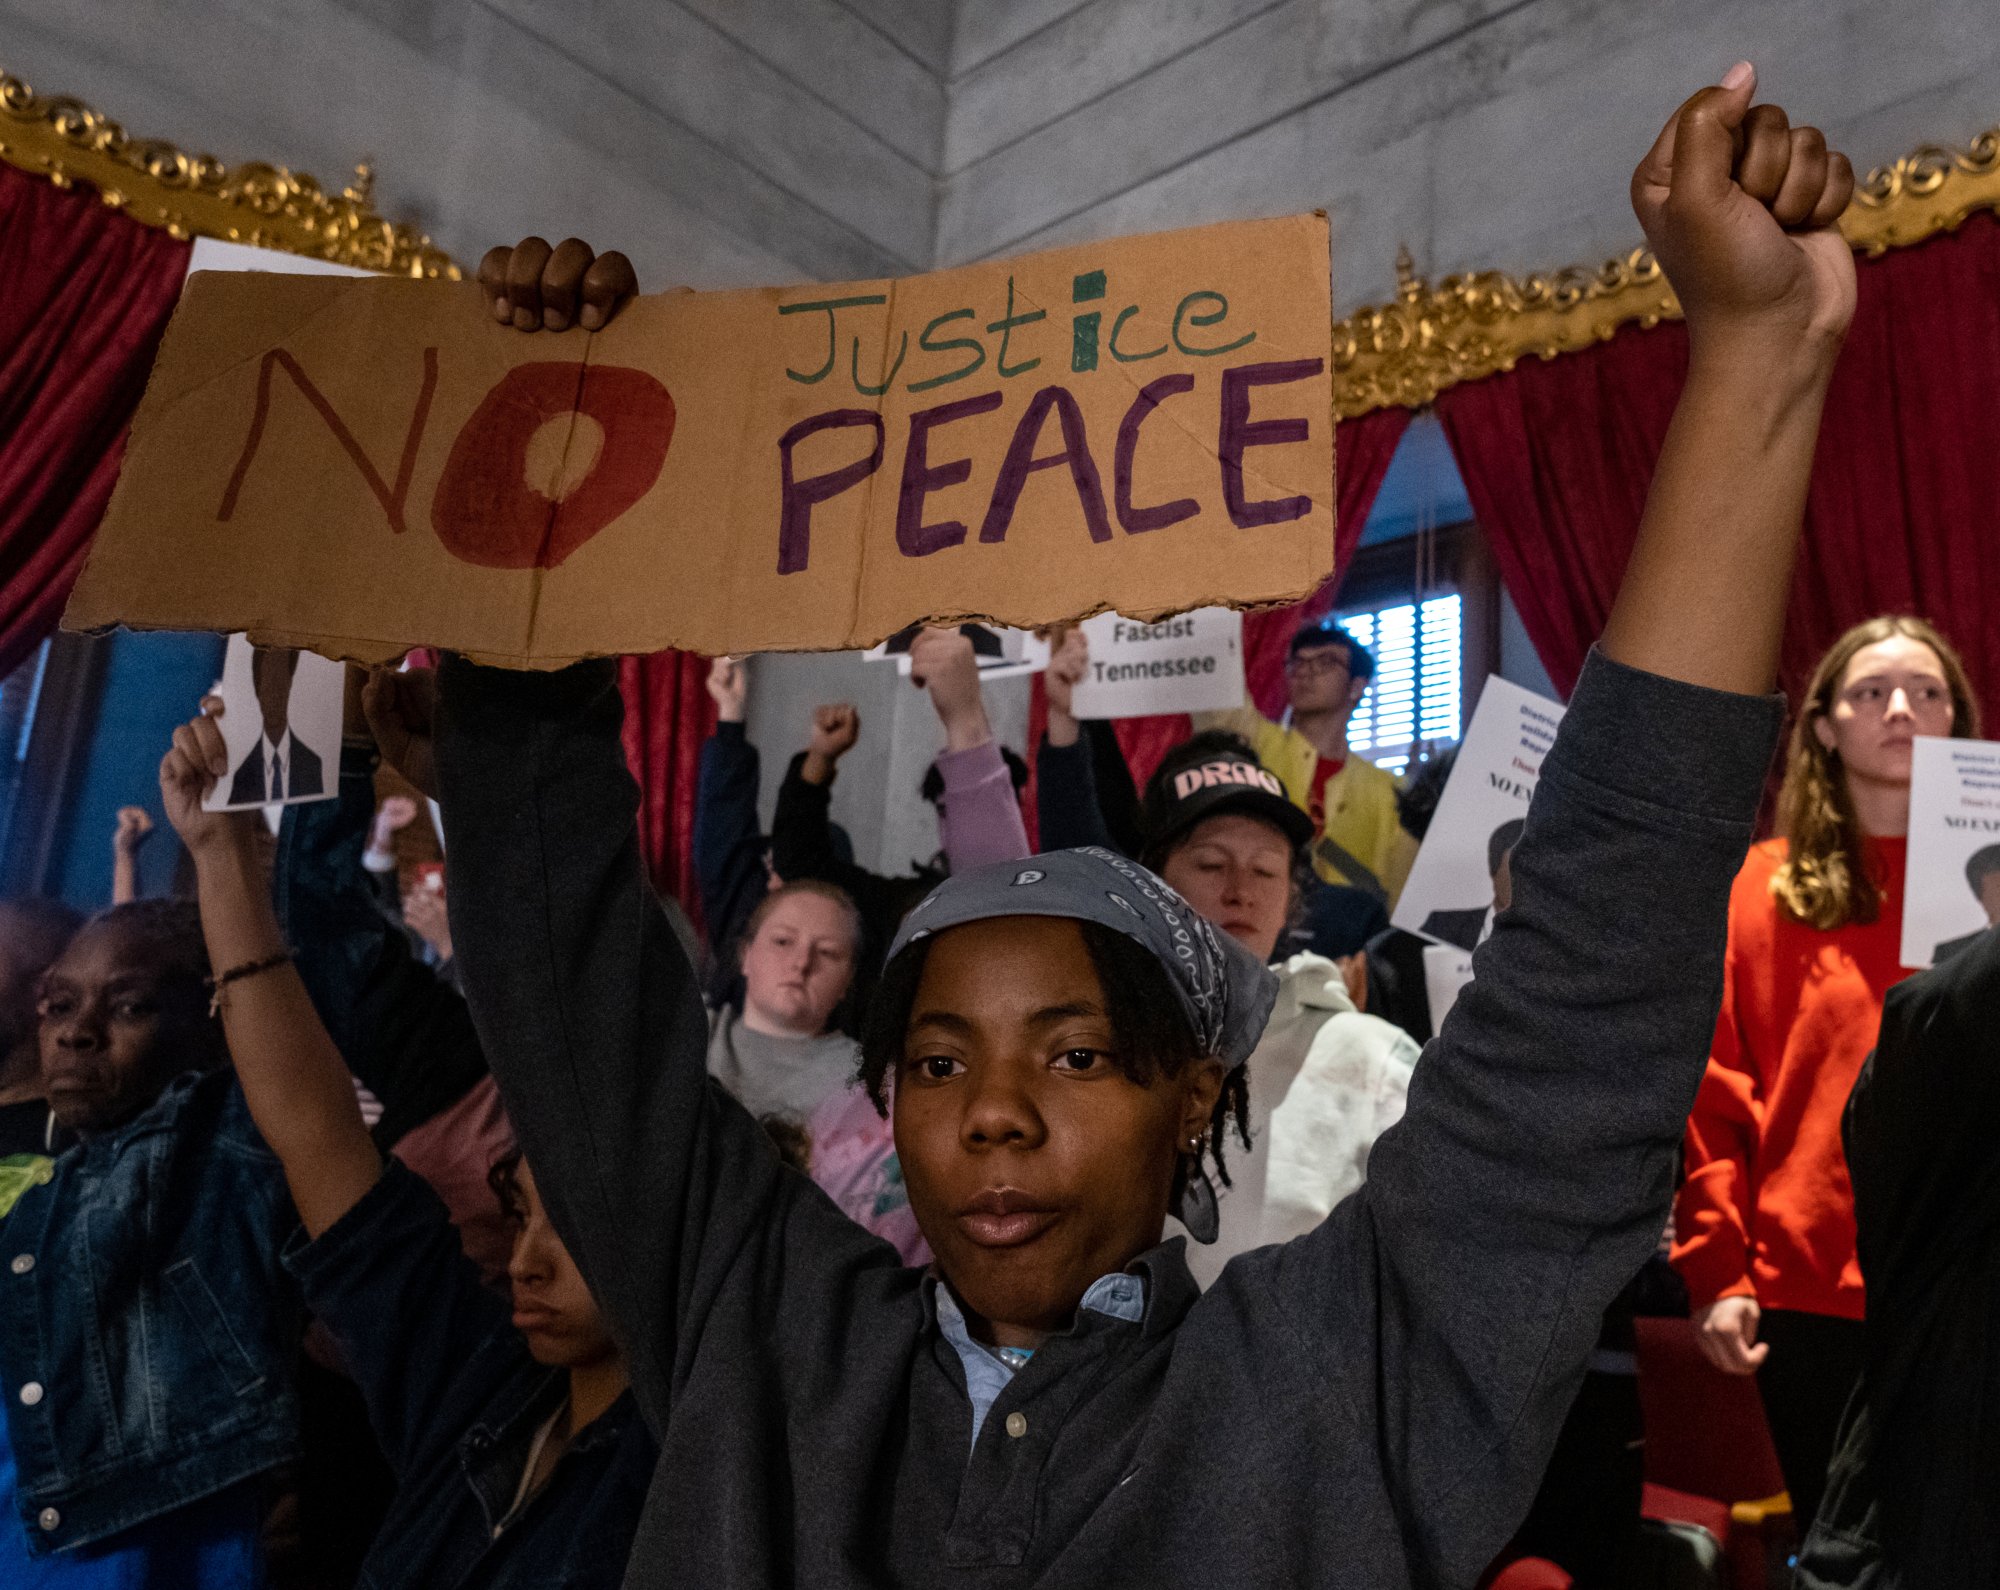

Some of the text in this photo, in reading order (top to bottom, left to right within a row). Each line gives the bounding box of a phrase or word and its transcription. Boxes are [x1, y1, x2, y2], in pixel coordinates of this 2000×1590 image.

[779, 269, 1256, 396] Justice
[217, 346, 677, 571] NO
[777, 358, 1324, 575] PEACE
[1113, 618, 1195, 643] Fascist
[1094, 655, 1217, 683] Tennessee
[1174, 761, 1283, 801] DRAG
[1487, 771, 1511, 793] NO
[1944, 814, 1967, 829] NO
